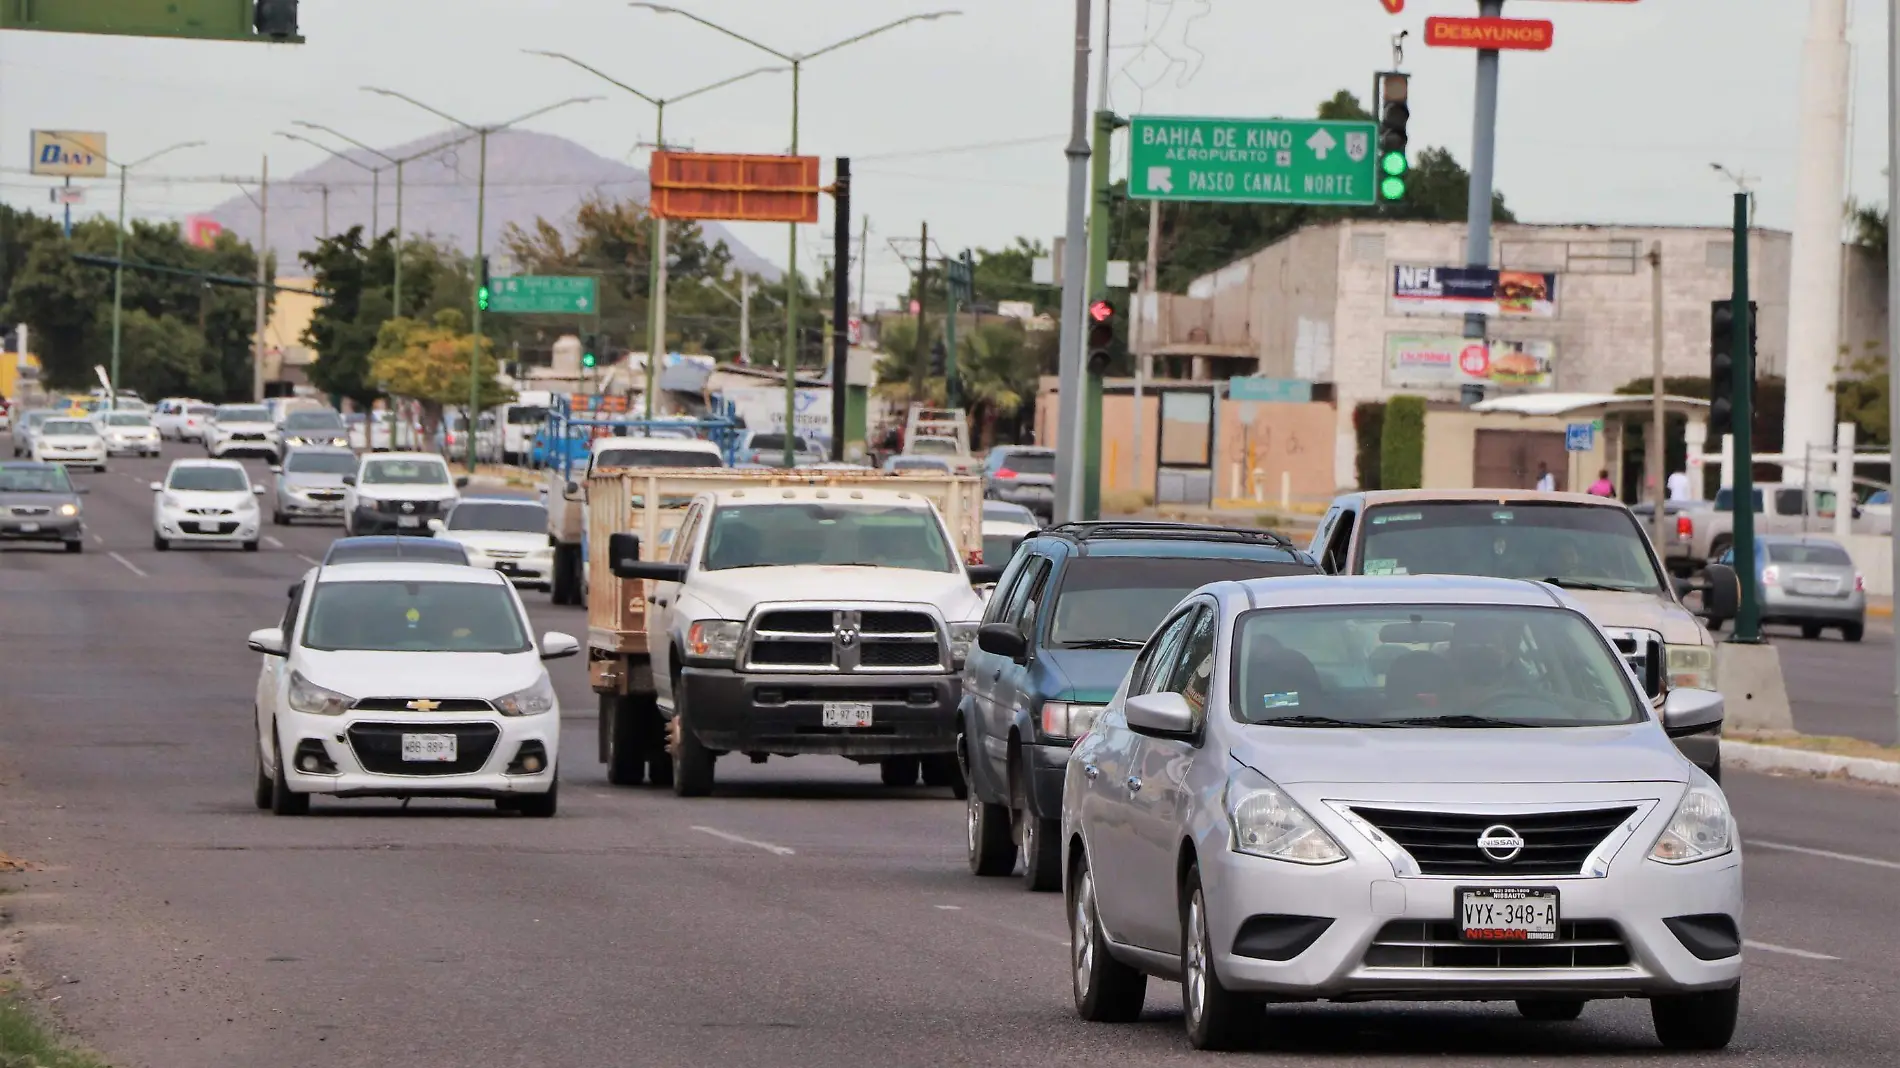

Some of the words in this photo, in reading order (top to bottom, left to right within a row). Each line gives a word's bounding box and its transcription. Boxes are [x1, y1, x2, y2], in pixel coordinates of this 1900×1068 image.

[1434, 23, 1544, 41] DESAYUNOS
[1143, 126, 1204, 146] BAHIA
[1213, 128, 1237, 147] DE
[1247, 128, 1292, 148] KINO
[1165, 149, 1268, 162] AEROPUERTO
[1188, 170, 1235, 192] PASEO
[1243, 172, 1292, 193] CANAL
[1304, 174, 1353, 195] NORTE
[1398, 267, 1442, 289] NFL
[1465, 904, 1554, 924] VYX-348-A
[1466, 928, 1527, 938] NISSAN
